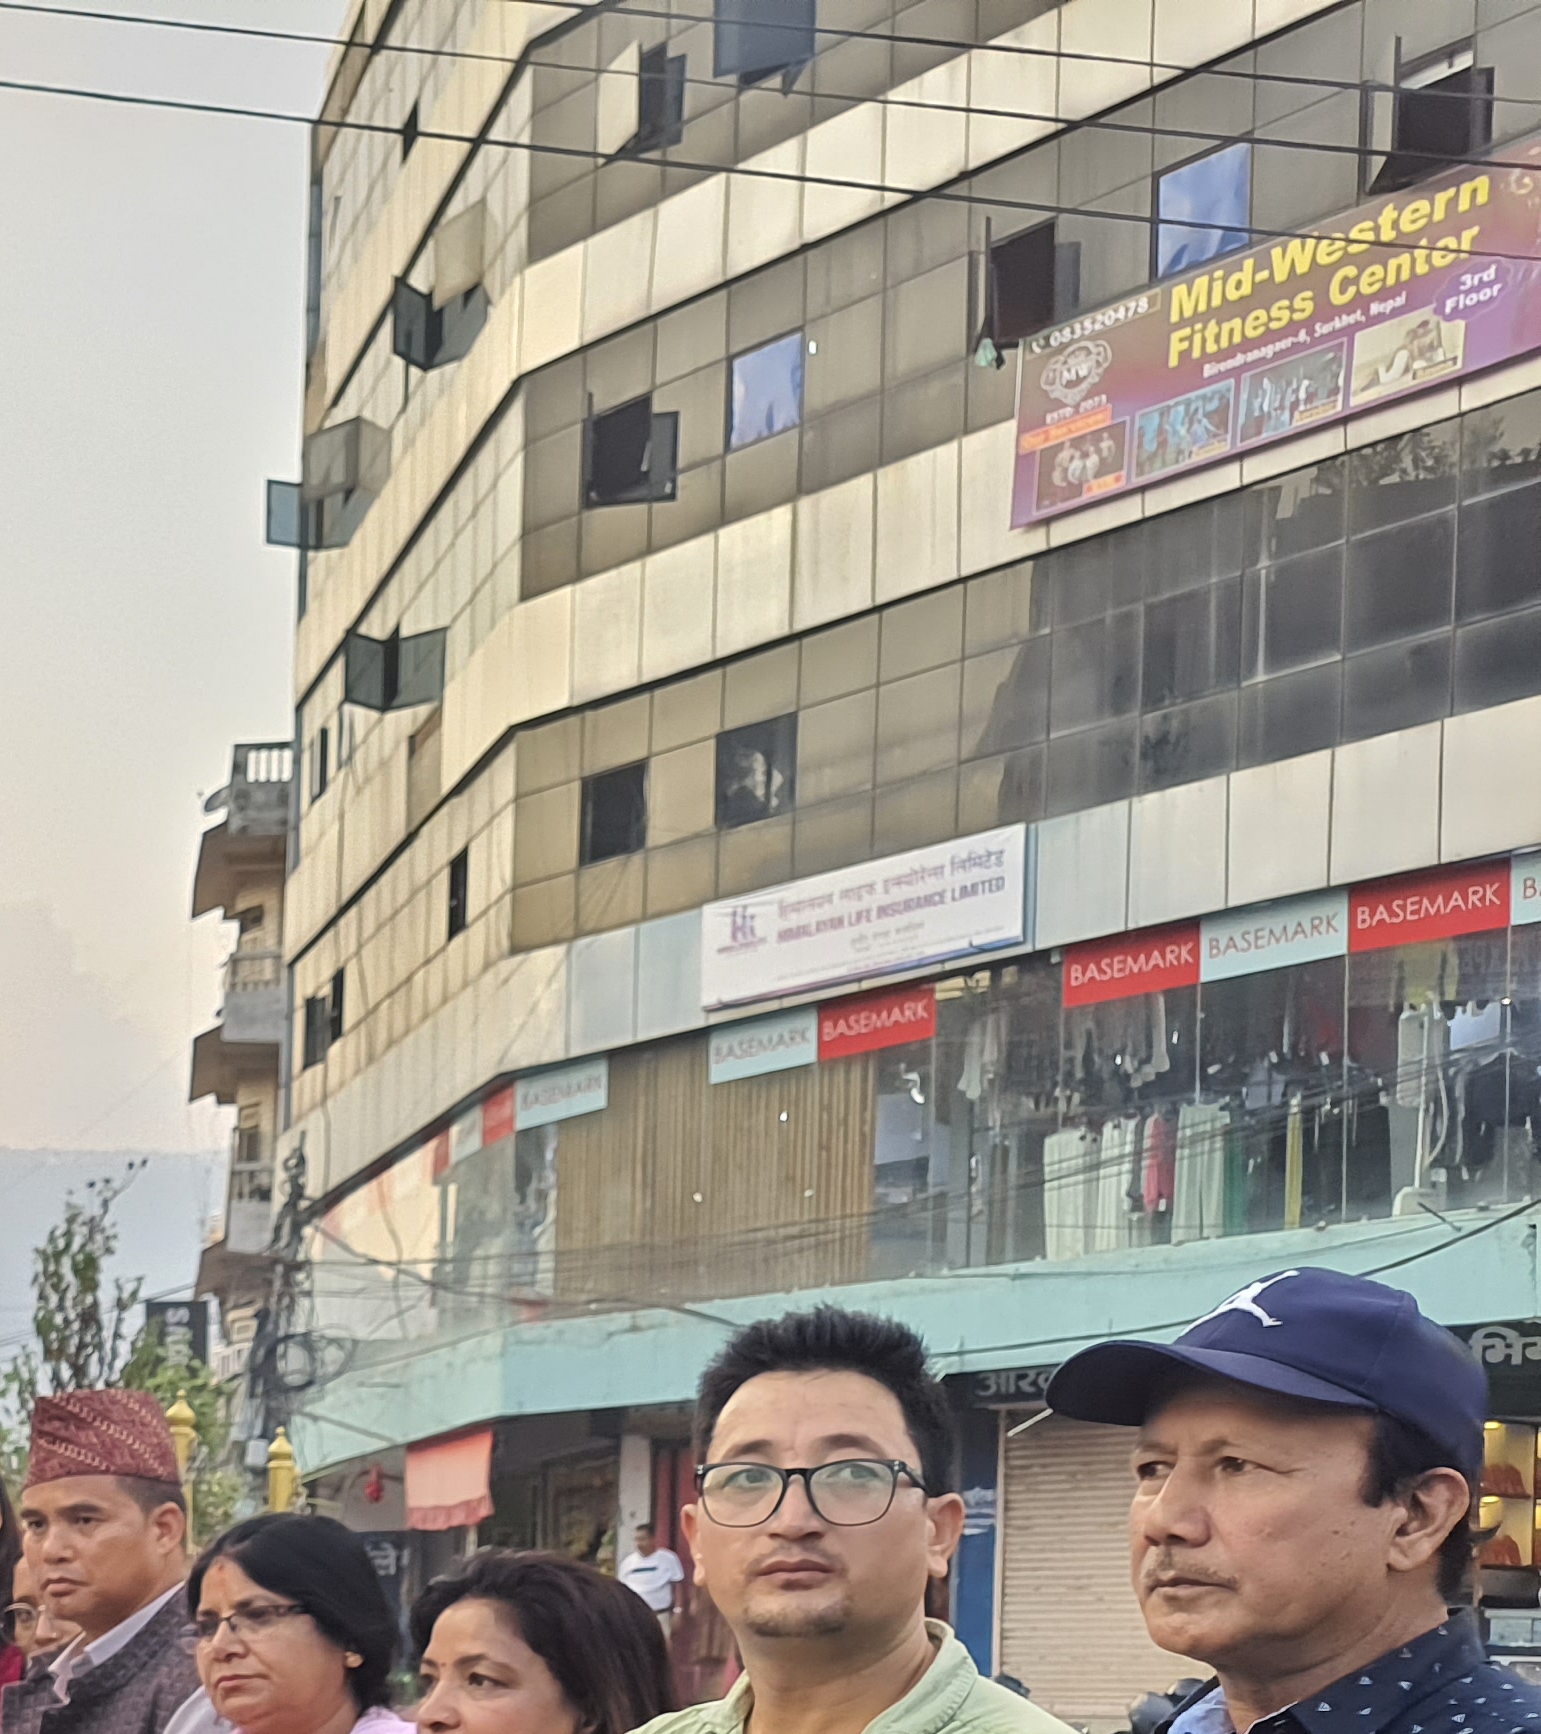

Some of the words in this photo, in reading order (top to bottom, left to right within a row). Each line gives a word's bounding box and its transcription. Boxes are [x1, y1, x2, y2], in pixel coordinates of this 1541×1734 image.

[1170, 174, 1490, 324] Mid-Western
[1168, 290, 1314, 368] Fitness
[1329, 225, 1481, 306] Center
[1444, 283, 1503, 315] Floor
[1459, 263, 1497, 292] 3rd
[1369, 291, 1407, 316] Nepal
[847, 908, 873, 927] LIFE
[951, 876, 1006, 902] LIMITED
[1355, 882, 1501, 929] BASEMARK
[1208, 912, 1340, 960] BASEMARK
[1070, 941, 1195, 987] BASEMARK
[822, 1000, 929, 1042] BASEMARK
[712, 1025, 811, 1065] BASEMARK
